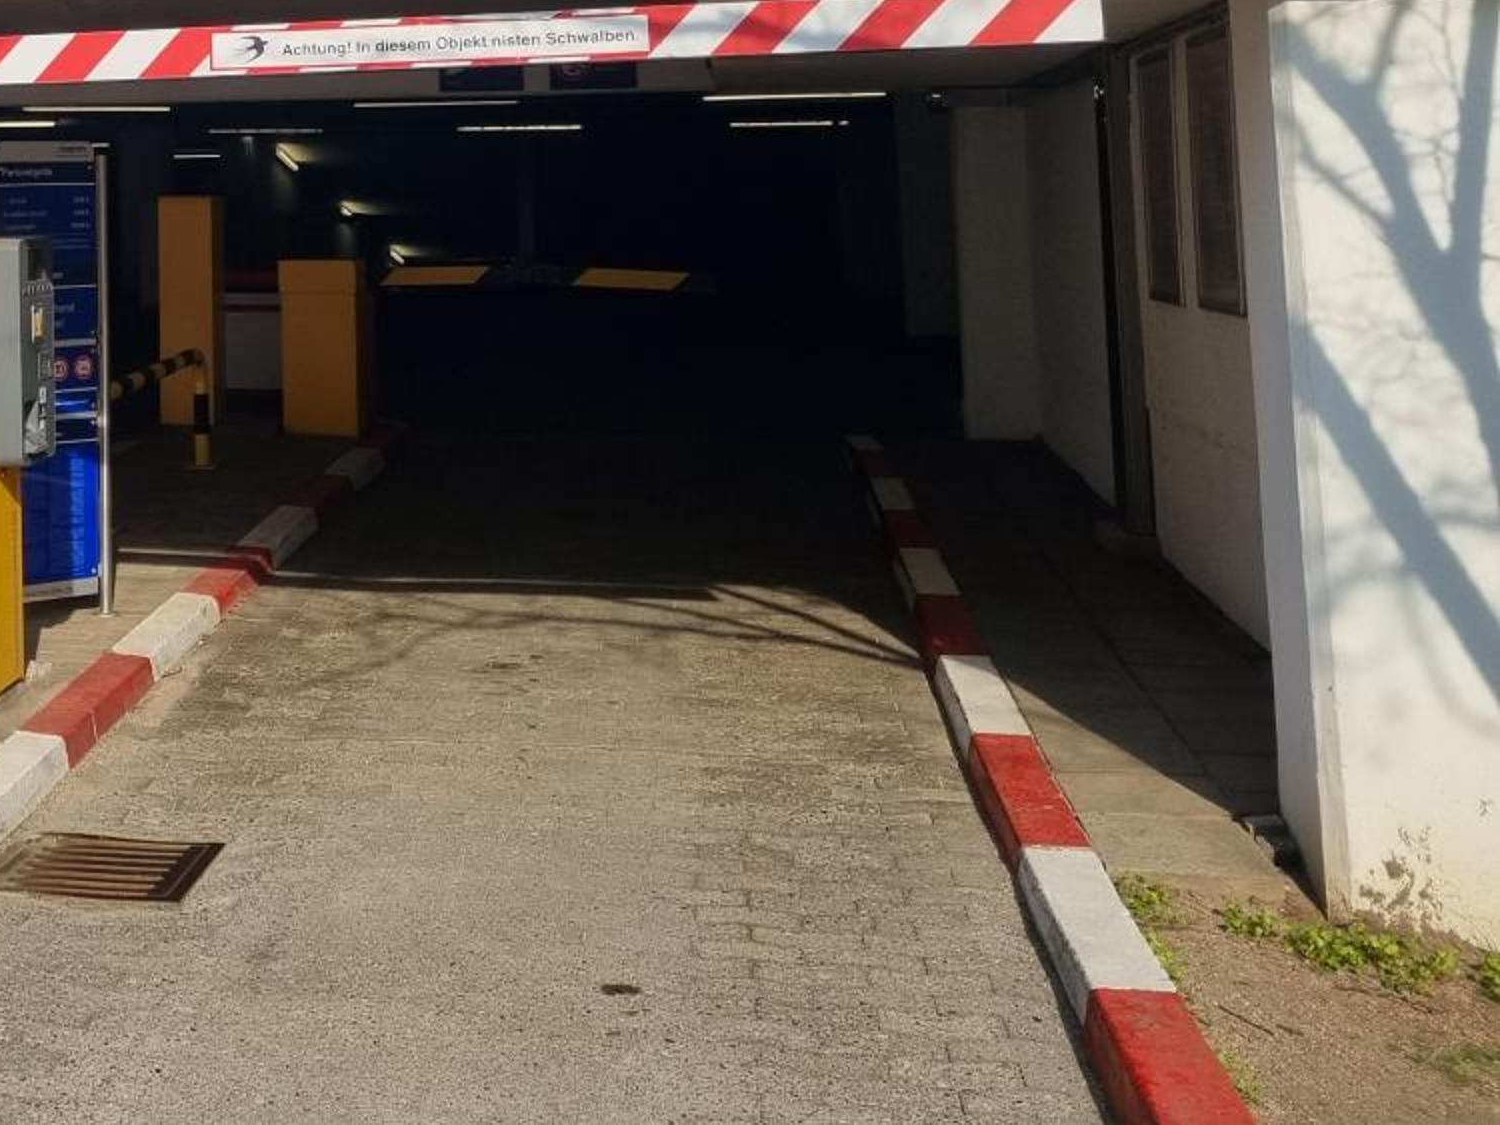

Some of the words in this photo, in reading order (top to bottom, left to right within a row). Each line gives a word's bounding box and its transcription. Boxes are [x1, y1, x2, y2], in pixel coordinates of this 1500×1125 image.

[282, 42, 352, 58] Achtung!
[357, 41, 371, 53] In
[375, 37, 431, 53] diesem
[436, 35, 488, 51] Objekt
[491, 32, 541, 48] nisten
